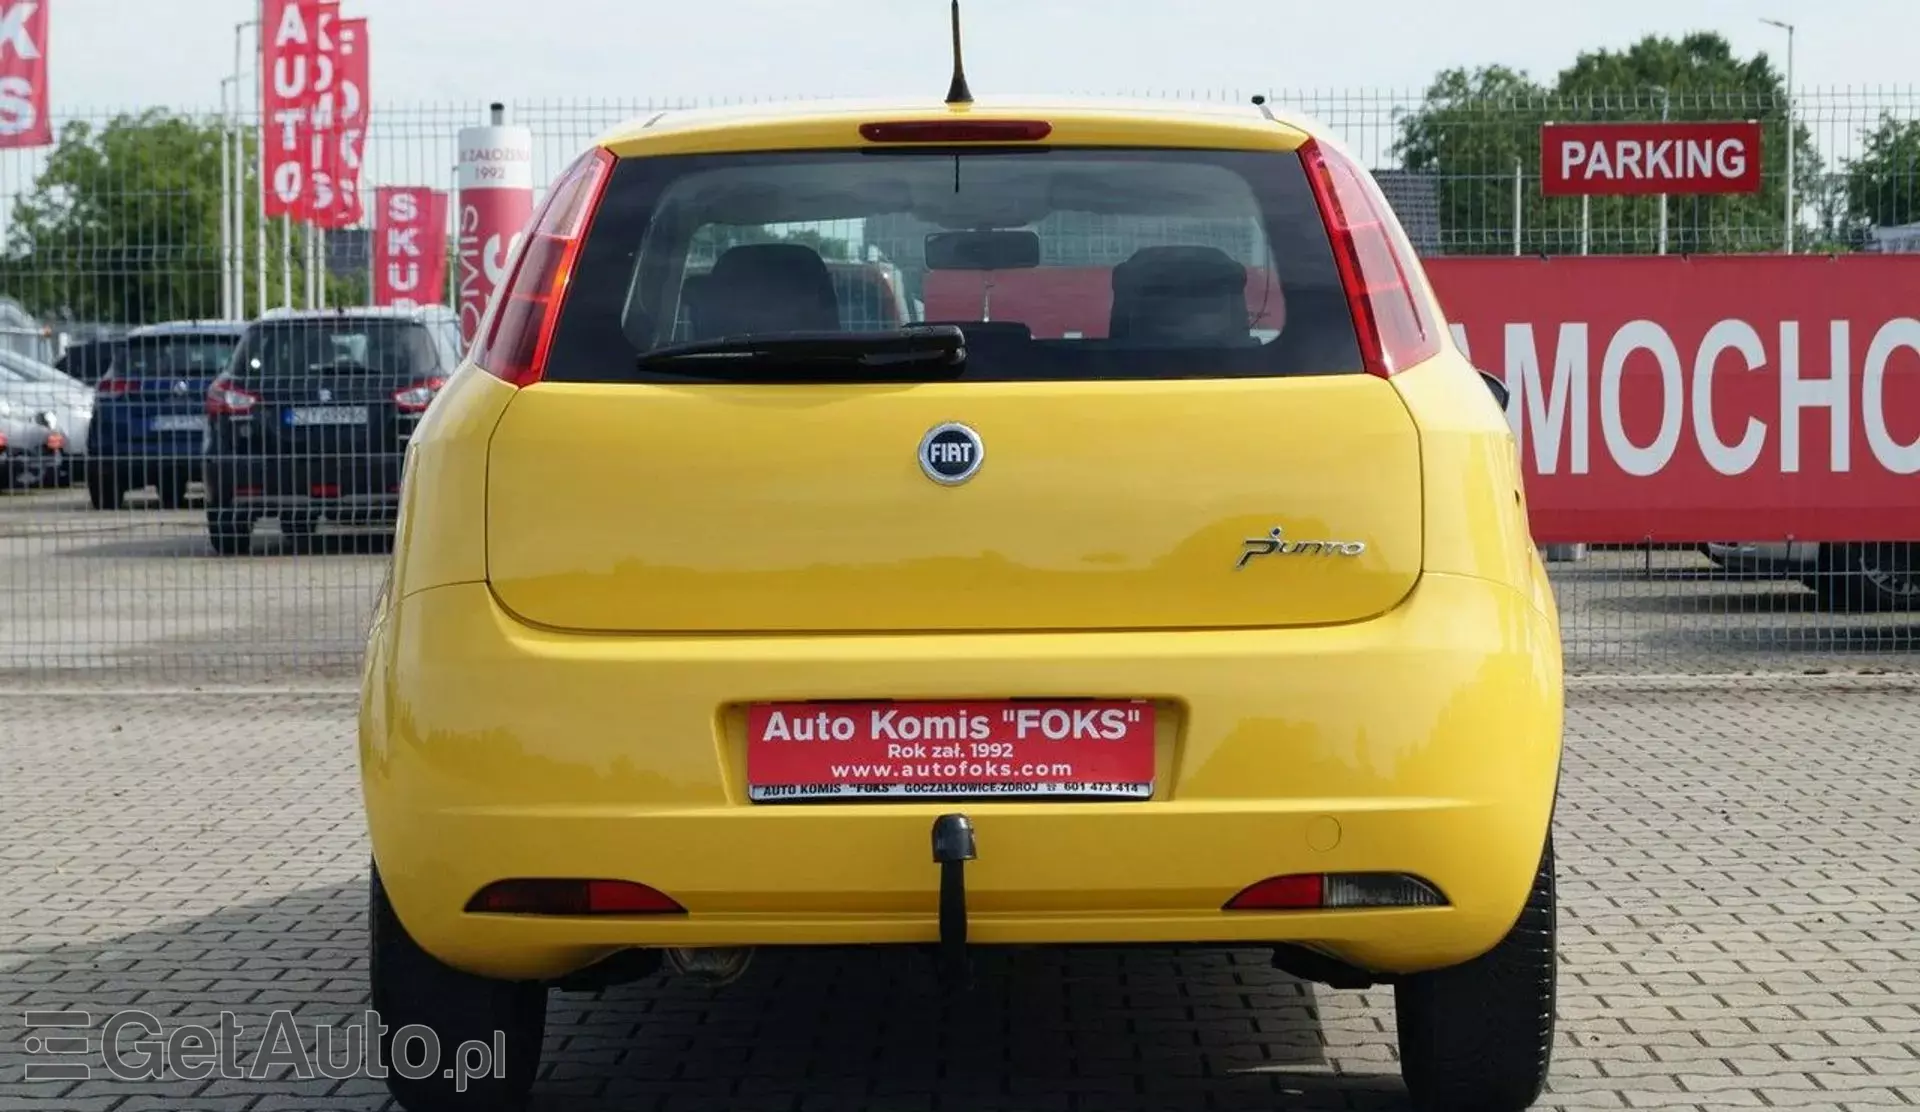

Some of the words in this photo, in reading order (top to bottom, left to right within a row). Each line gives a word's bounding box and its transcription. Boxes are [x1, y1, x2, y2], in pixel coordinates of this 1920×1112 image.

[274, 3, 308, 204] AUTO
[1561, 138, 1746, 180] PARKING
[475, 165, 505, 179] 1992
[1447, 317, 1920, 477] MOCHO
[930, 442, 972, 462] FIAT
[762, 711, 856, 742] Auto
[871, 709, 991, 740] Komis
[1003, 709, 1140, 740] "FOKS"
[887, 743, 927, 759] Rok
[931, 742, 966, 759] zał.
[969, 742, 1014, 758] 1992
[831, 761, 1072, 777] www.autofoks.com
[763, 784, 797, 797] AUTO
[800, 783, 842, 795] KOMIS
[1064, 782, 1086, 792] 601
[1090, 782, 1113, 793] 473
[1116, 782, 1139, 793] 414
